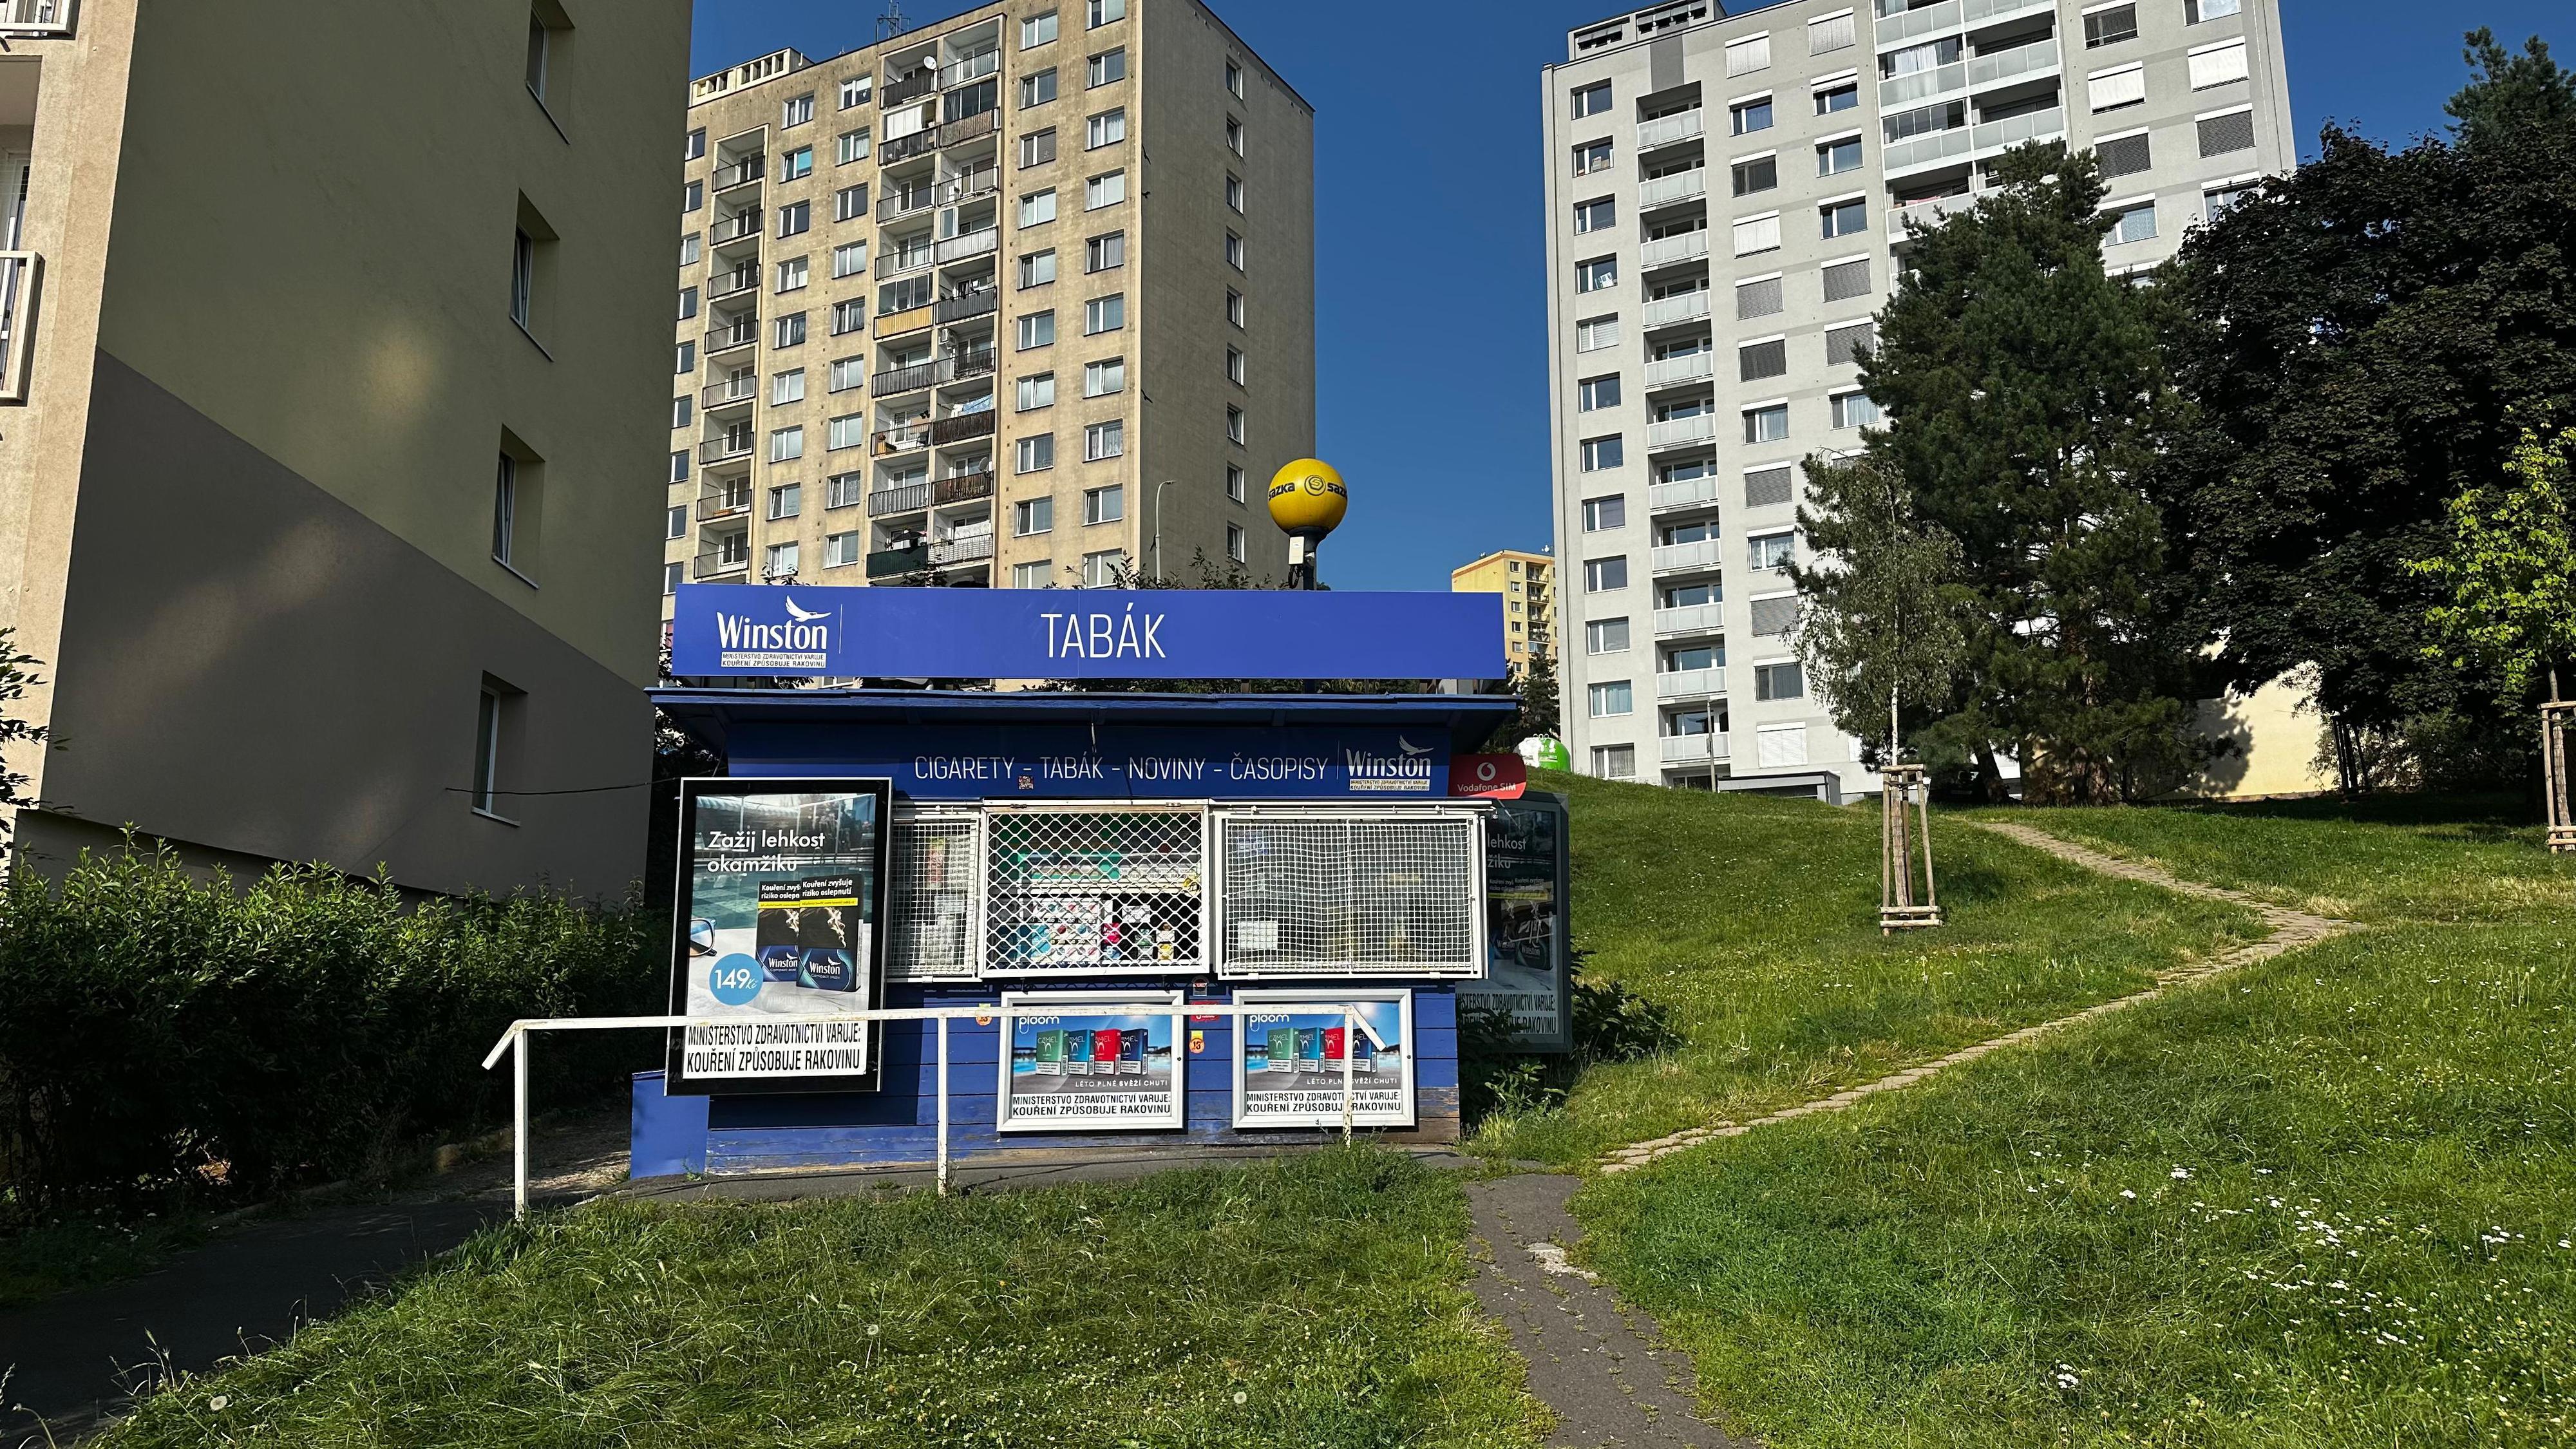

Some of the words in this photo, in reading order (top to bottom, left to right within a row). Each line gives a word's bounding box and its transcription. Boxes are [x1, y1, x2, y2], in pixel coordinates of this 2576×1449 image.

[717, 612, 828, 650] Winston
[1040, 602, 1166, 658] TABÁK
[915, 756, 1015, 779] CIGARETY
[1039, 751, 1103, 779] TABÁK
[1129, 757, 1206, 780] NOVINY
[1231, 752, 1329, 780] ČASOPISY
[1345, 748, 1431, 777] Winston
[1457, 784, 1498, 792] Vodafone
[1500, 783, 1517, 791] SIM
[708, 831, 756, 853] Zažij
[762, 829, 826, 848] lehkost
[1487, 833, 1526, 850] lehkost
[707, 854, 797, 873] okamžiku
[1487, 853, 1511, 869] žiku
[802, 880, 827, 888] Kouření
[828, 878, 853, 887] zvyšuje
[802, 888, 820, 896] riziko
[820, 887, 852, 896] oslepnutí
[768, 957, 798, 968] Winston
[809, 961, 840, 974] Winston
[1019, 1016, 1060, 1034] ploom
[1249, 1014, 1290, 1032] ploom
[688, 1024, 752, 1046] MINISTERSTVO
[826, 1023, 860, 1043] VARUJE:
[687, 1047, 737, 1072] KOUŘENÍ
[738, 1046, 802, 1072] ZPŮSOBUJE
[804, 1049, 860, 1070] RAKOVINU
[1119, 1079, 1142, 1087] SVĚŽÍ
[1013, 1095, 1072, 1105] MINISTERSTVO
[1074, 1094, 1137, 1104] ZDRAVOTNICTVÍ
[1247, 1092, 1304, 1102] MINISTERSTVO
[1306, 1090, 1367, 1101] ZDRAVOTCTVÍ
[1013, 1104, 1057, 1116] KOUŘENÍ
[1059, 1104, 1117, 1115] ZPŮSOBUJE
[1121, 1104, 1170, 1114] RAKOVINU
[1247, 1102, 1289, 1113] KOUŘENÍ
[1293, 1101, 1343, 1112] ZPŮSOBUJ
[1352, 1102, 1401, 1112] RAKOVINU
